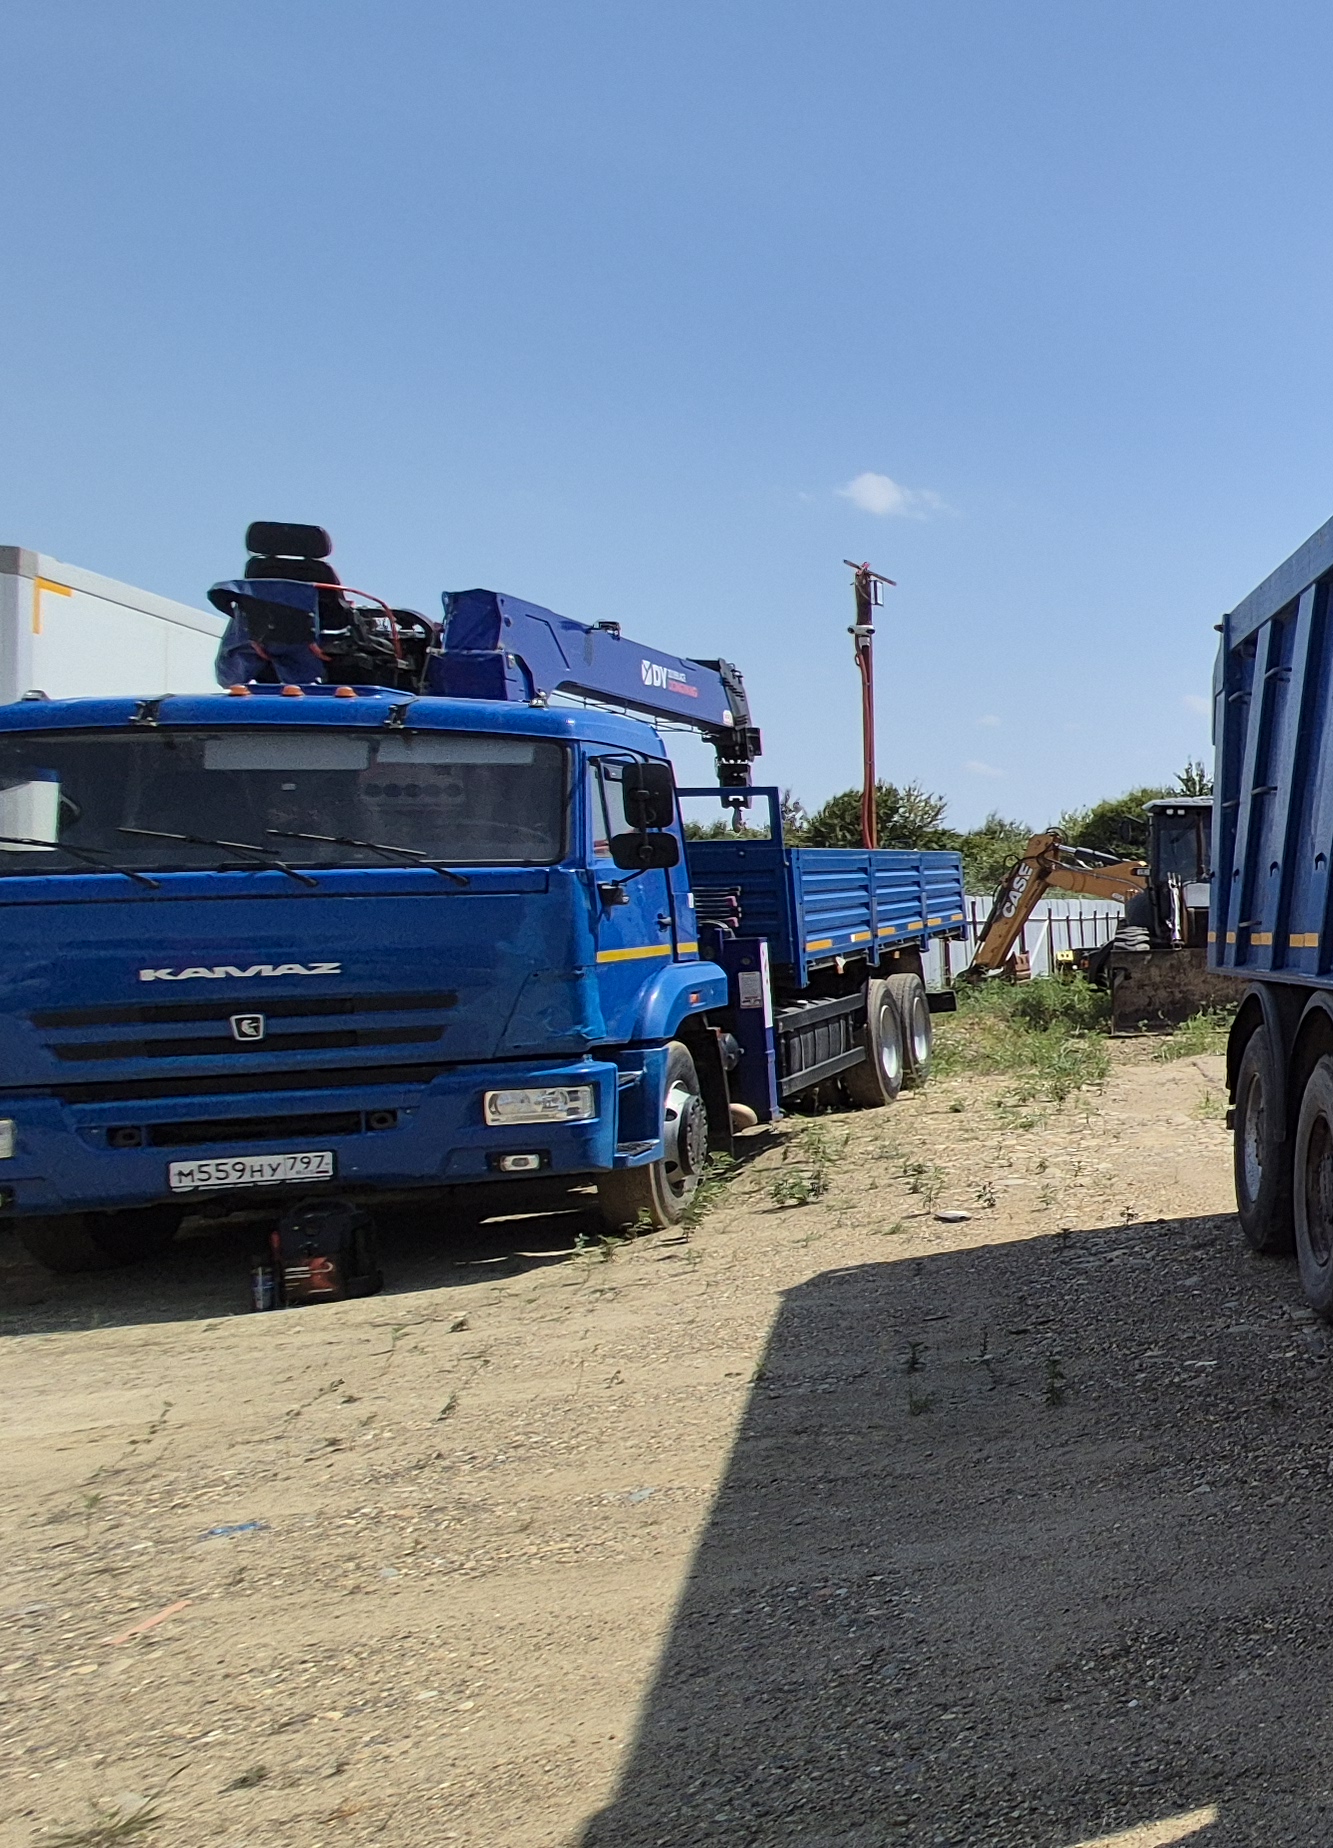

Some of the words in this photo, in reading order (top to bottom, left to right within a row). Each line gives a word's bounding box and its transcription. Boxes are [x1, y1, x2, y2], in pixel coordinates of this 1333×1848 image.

[1002, 862, 1034, 918] CASE
[139, 962, 342, 982] KAMAZ
[285, 1155, 326, 1172] 797
